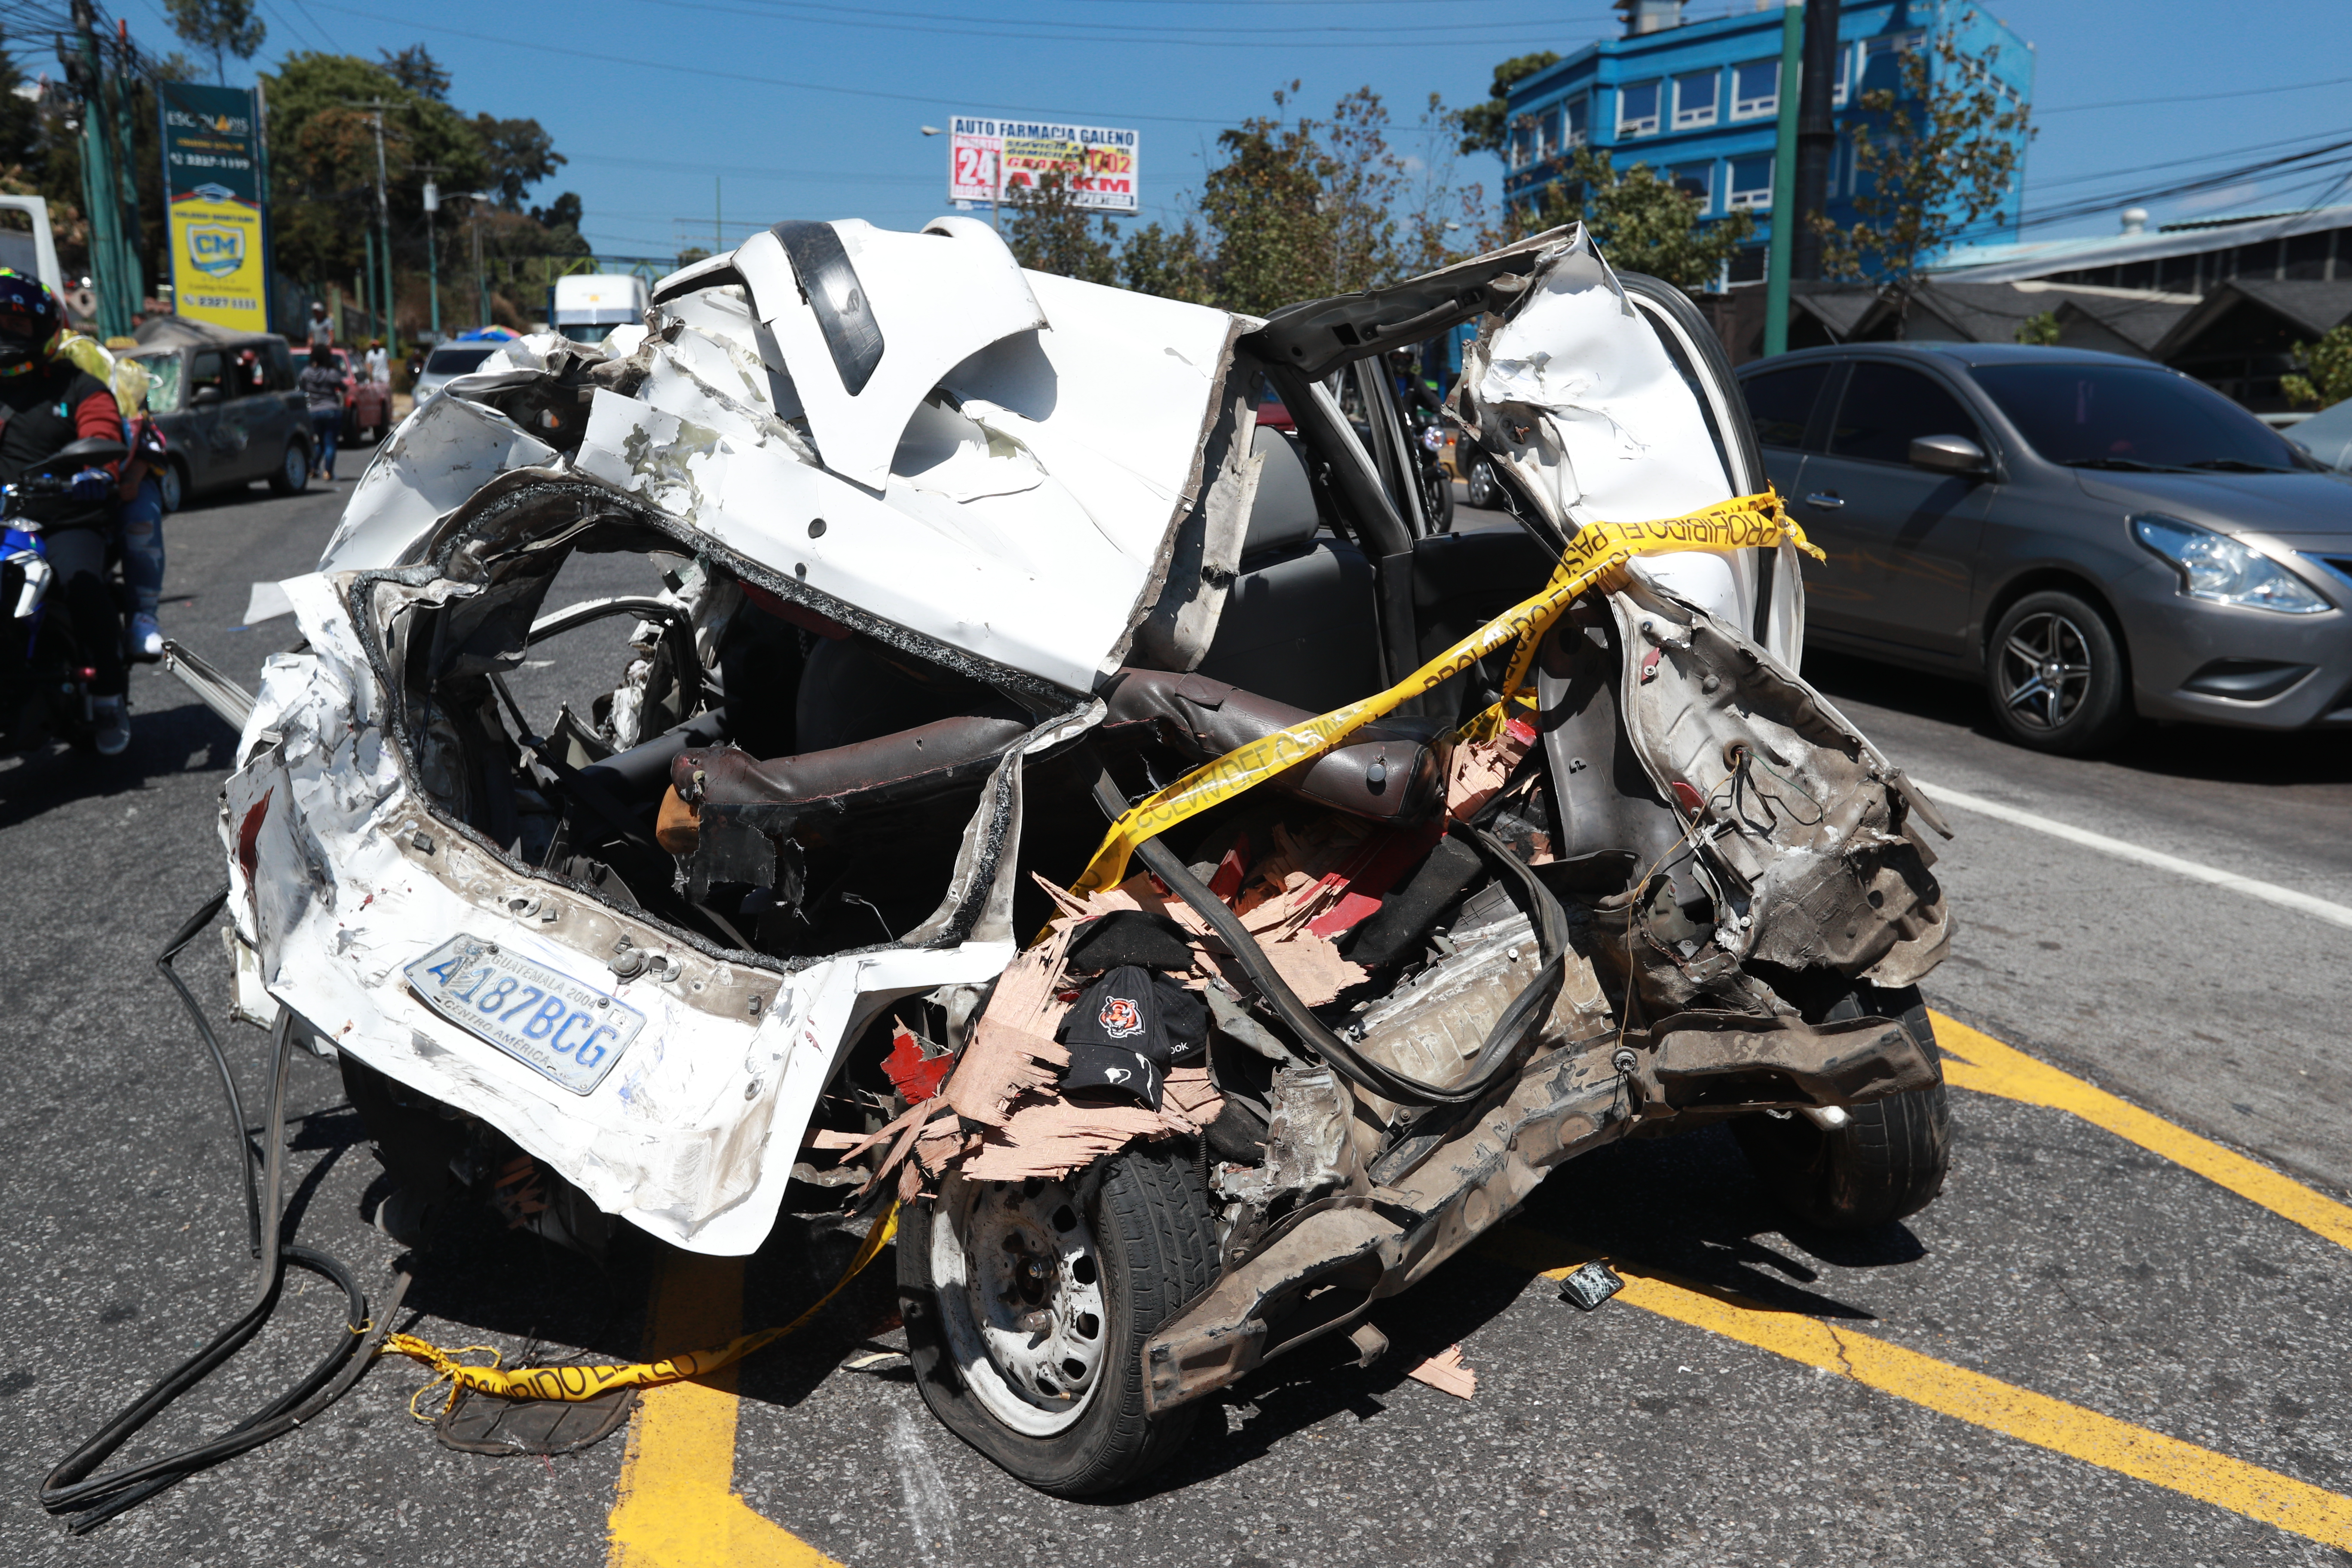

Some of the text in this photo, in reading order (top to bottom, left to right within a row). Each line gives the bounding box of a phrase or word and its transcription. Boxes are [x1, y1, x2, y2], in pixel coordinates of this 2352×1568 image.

[956, 119, 1133, 145] AUTO FARMACIA GALENO
[1006, 141, 1067, 150] SERVICIO
[959, 149, 996, 185] 24
[1007, 157, 1081, 171] GRATIS
[195, 235, 237, 255] CM
[1647, 514, 1778, 546] PROHIBIDO
[491, 954, 597, 1011] GUATEMALA 2004
[443, 999, 550, 1066] CENTRO AMÉRICA
